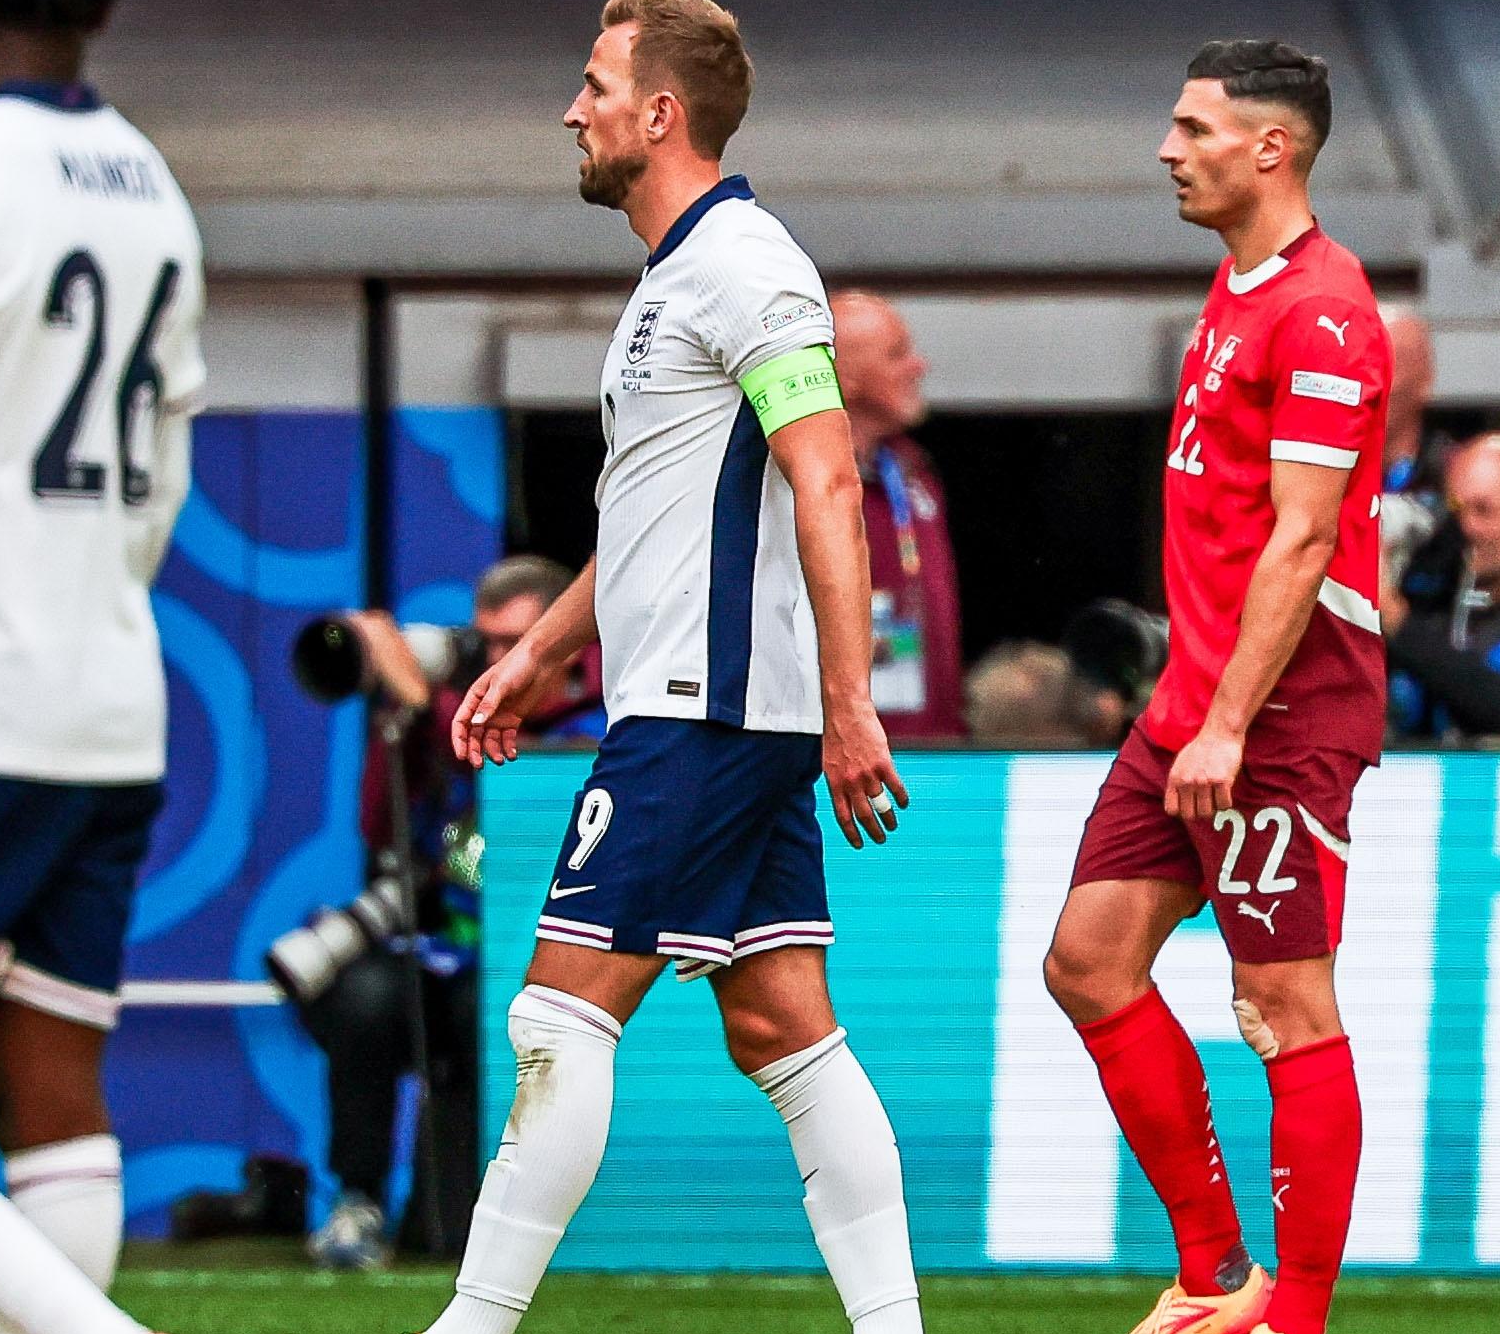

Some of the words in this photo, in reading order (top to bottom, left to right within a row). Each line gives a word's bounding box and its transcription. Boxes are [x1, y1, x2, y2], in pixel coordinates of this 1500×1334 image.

[763, 302, 818, 332] FOUNDATIO
[33, 247, 181, 505] 26
[567, 787, 614, 871] 9
[1213, 805, 1298, 895] 22
